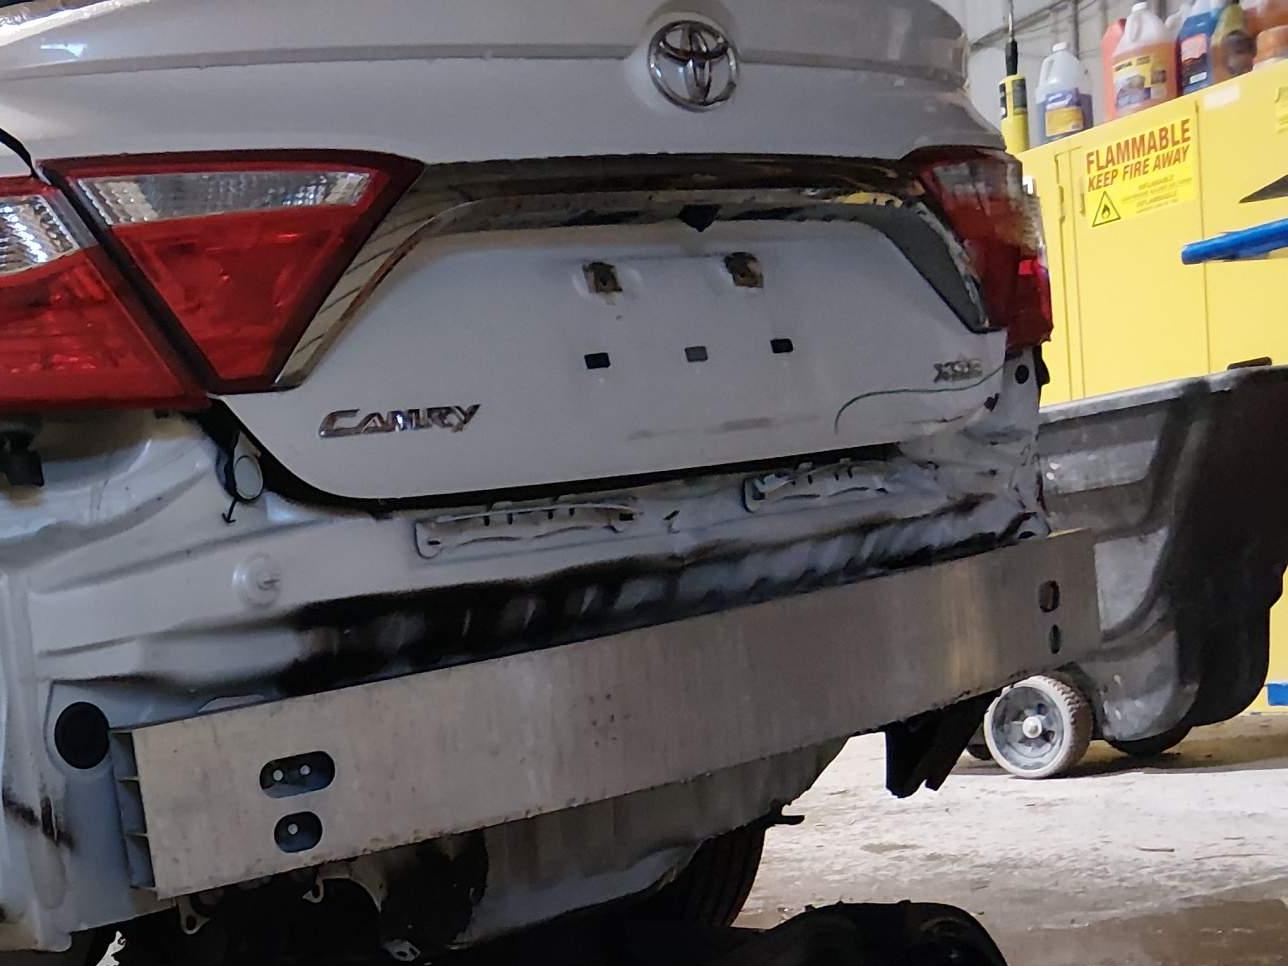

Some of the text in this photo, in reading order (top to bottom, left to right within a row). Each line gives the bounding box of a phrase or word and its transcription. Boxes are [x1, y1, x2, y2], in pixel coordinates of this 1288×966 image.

[1086, 118, 1191, 174] FLAMMABLE
[1088, 169, 1118, 192] KEEP
[1123, 158, 1150, 181] FIRE
[1153, 144, 1190, 172] AWAY
[318, 403, 481, 438] CAMRY
